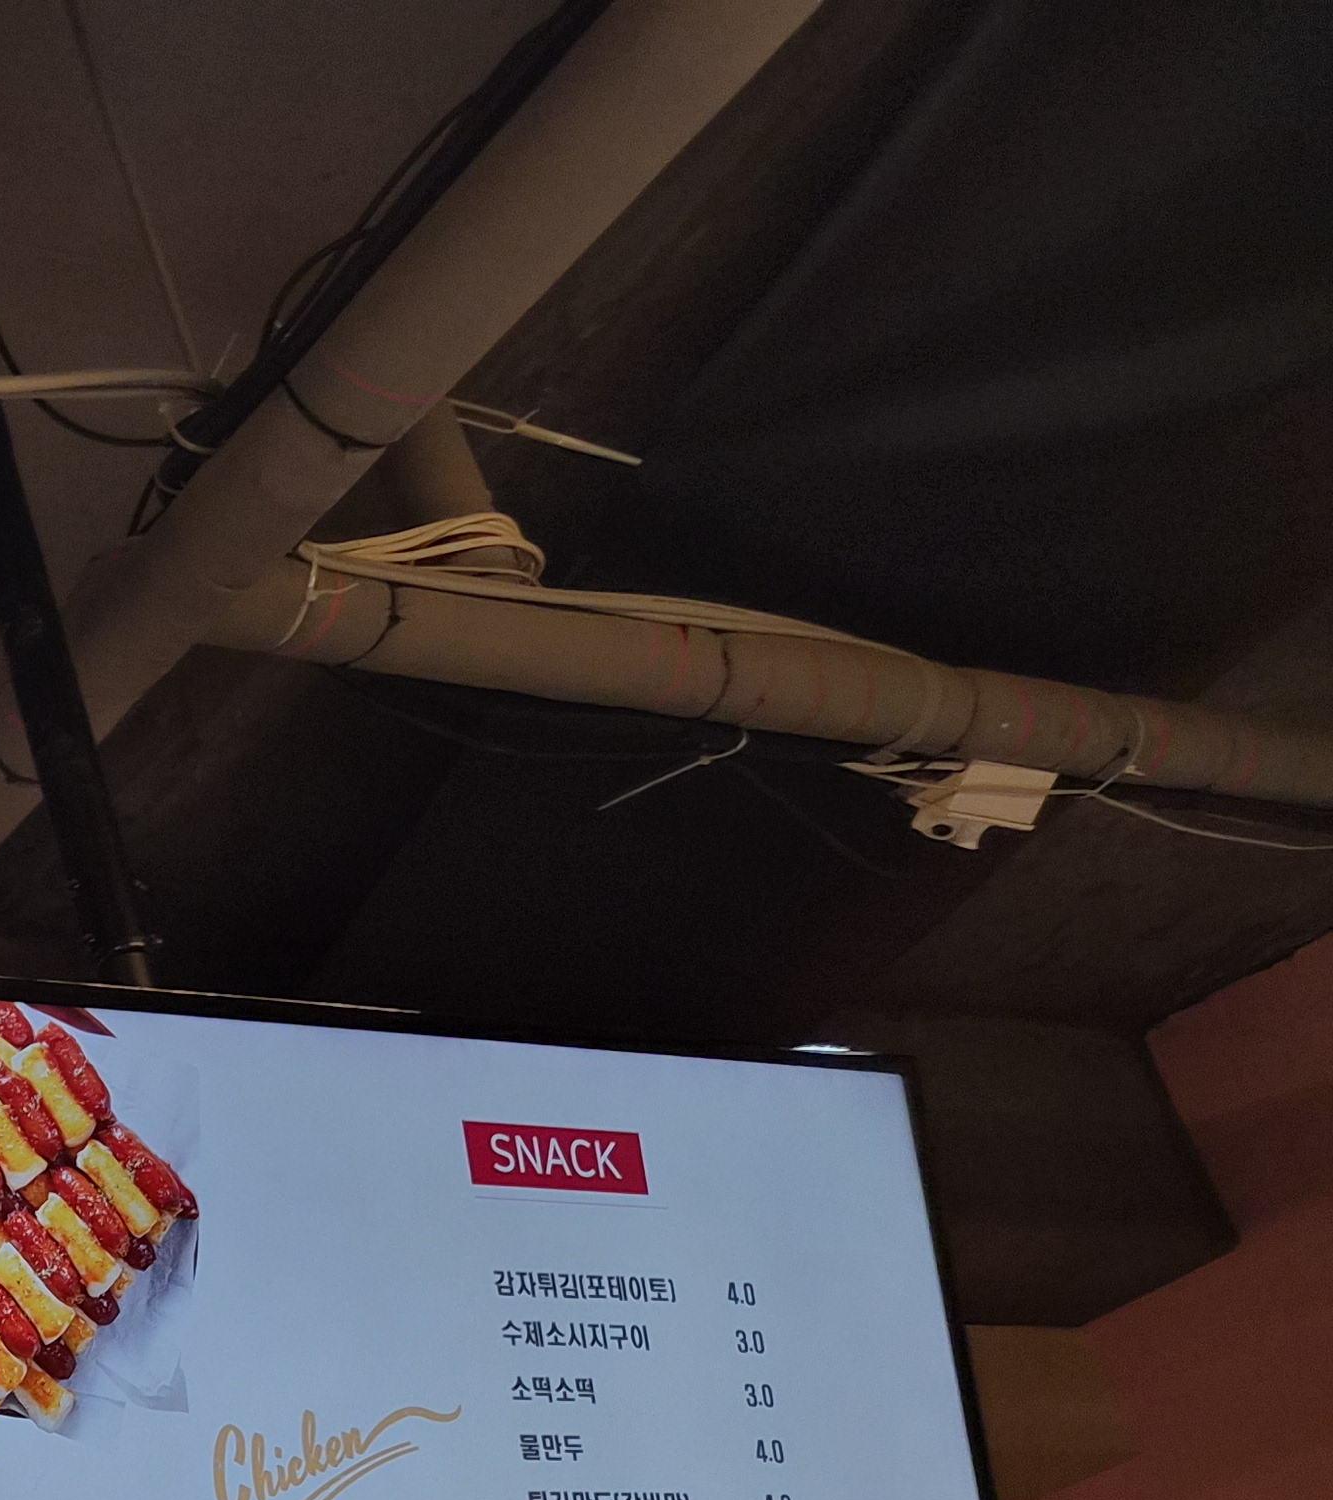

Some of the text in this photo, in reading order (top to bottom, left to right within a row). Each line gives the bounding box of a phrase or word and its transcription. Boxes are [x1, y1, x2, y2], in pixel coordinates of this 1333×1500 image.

[491, 1134, 622, 1179] SNACK
[494, 1271, 755, 1305] 감자튀김(포테이토) 4.0
[502, 1321, 764, 1354] 수제소시지구이 3.0
[512, 1377, 773, 1407] 소떡소떡 3.0
[520, 1435, 784, 1463] 물만두 4.0
